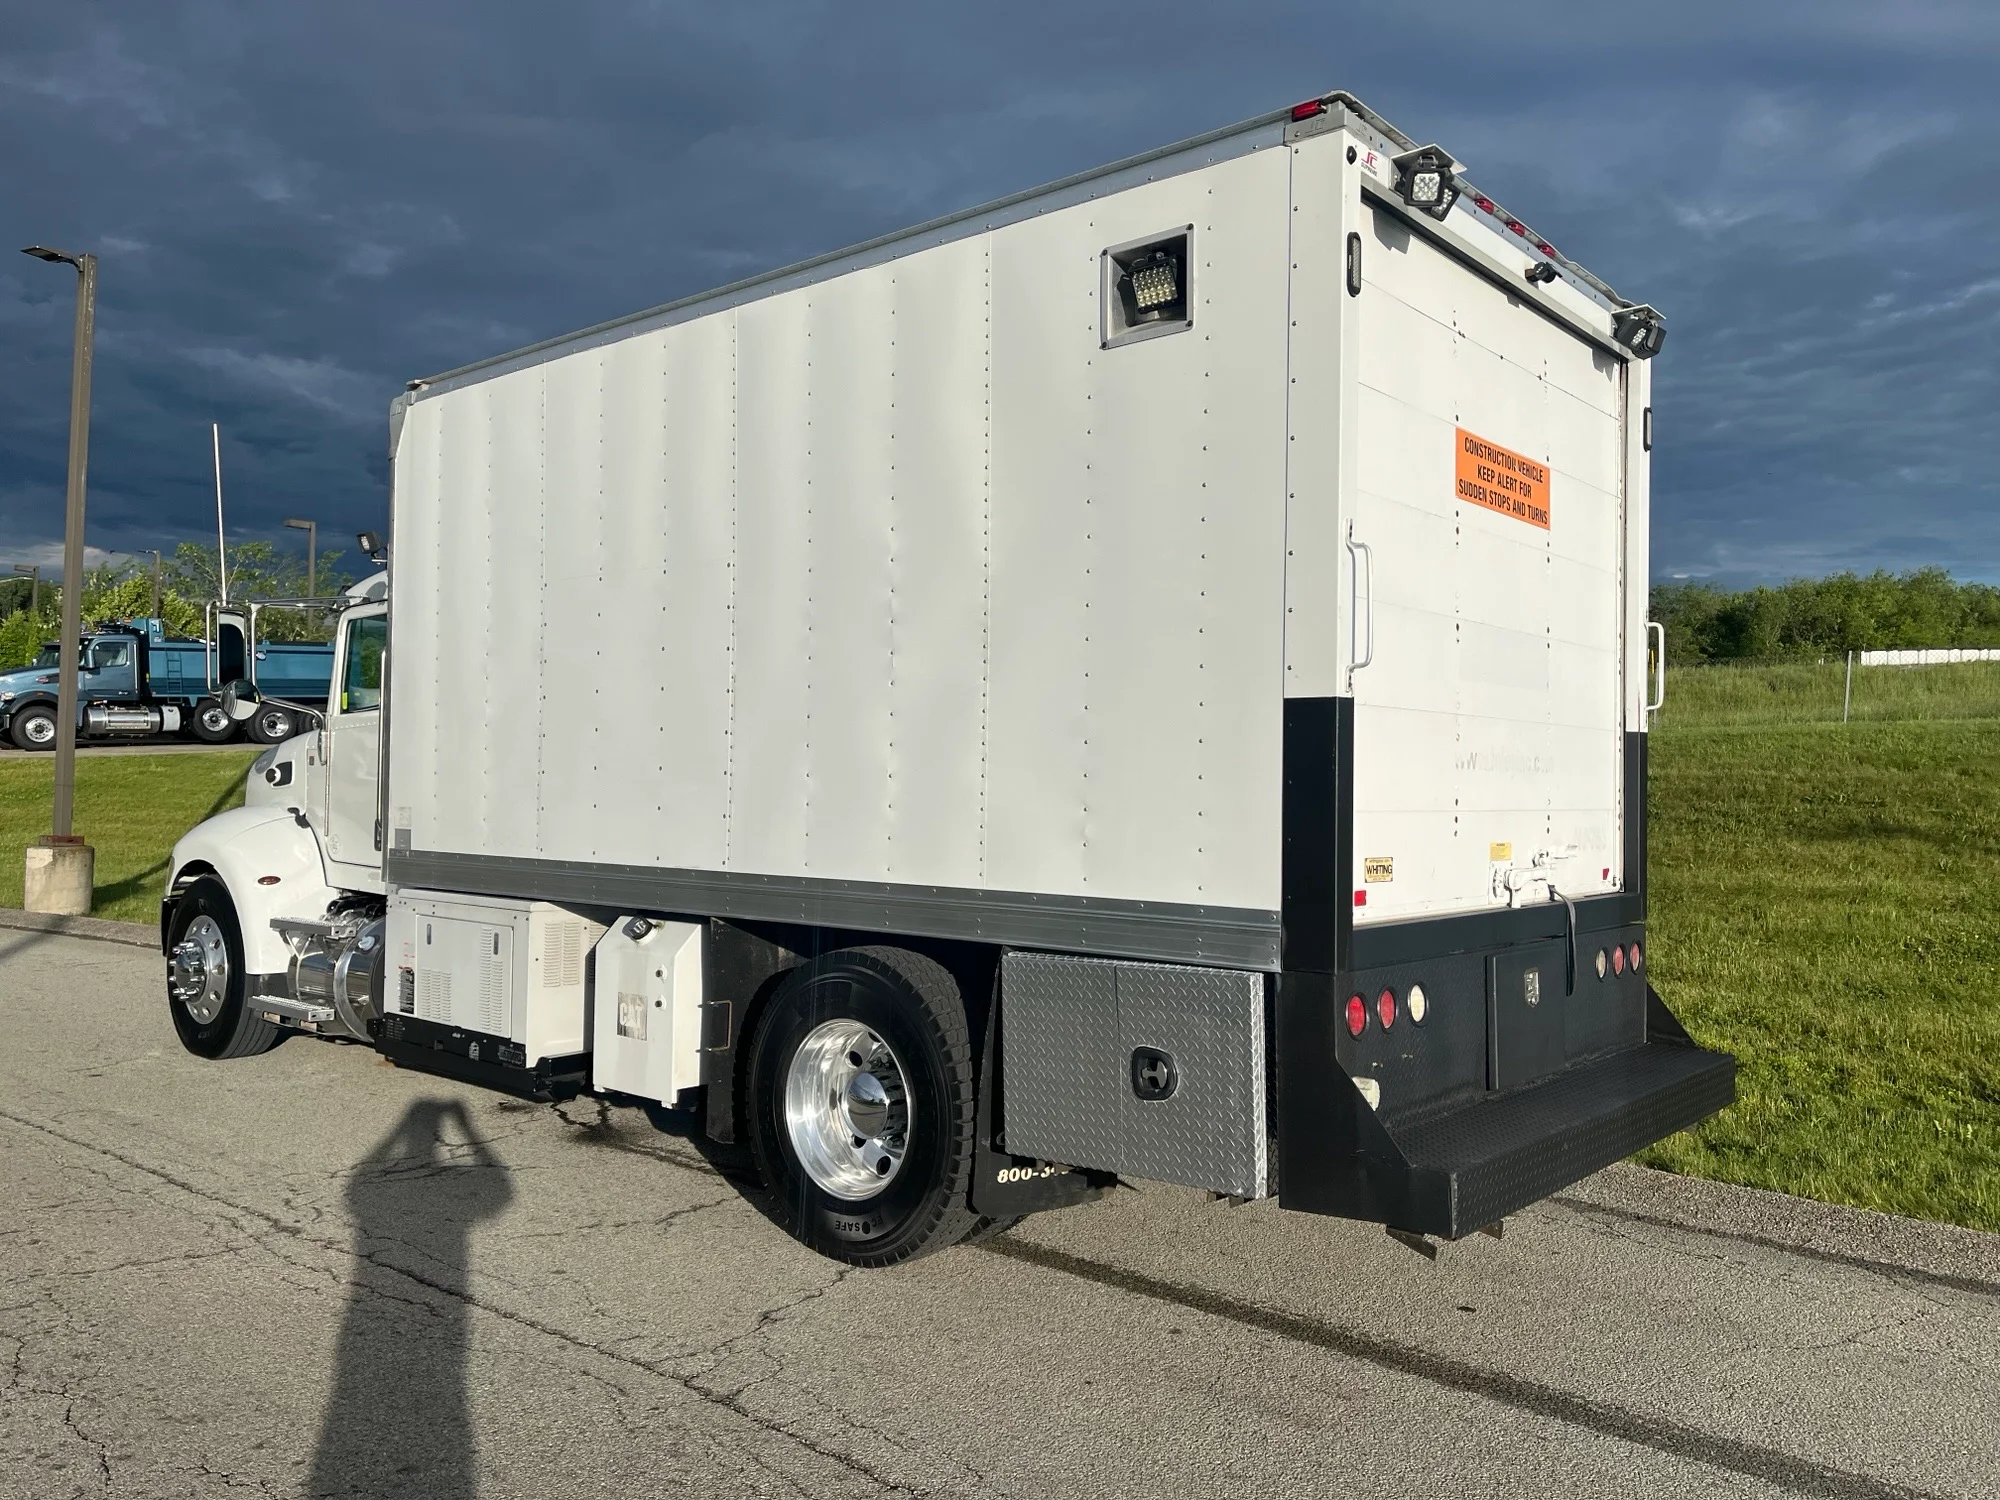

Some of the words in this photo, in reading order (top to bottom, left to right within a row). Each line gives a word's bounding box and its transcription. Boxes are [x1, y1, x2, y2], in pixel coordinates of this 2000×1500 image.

[1465, 437, 1516, 472] CONSTRUCTION
[1517, 459, 1543, 483] VEHICLE
[1478, 464, 1495, 483] KEEP
[1497, 473, 1517, 493] ALERT
[1520, 481, 1532, 499] FOR
[1459, 479, 1487, 503] SUDDEN
[1489, 490, 1511, 511] STOPS
[1513, 499, 1526, 517] AND
[1528, 504, 1548, 525] TURNS
[1366, 864, 1392, 875] WHITING
[620, 1002, 643, 1028] CAT
